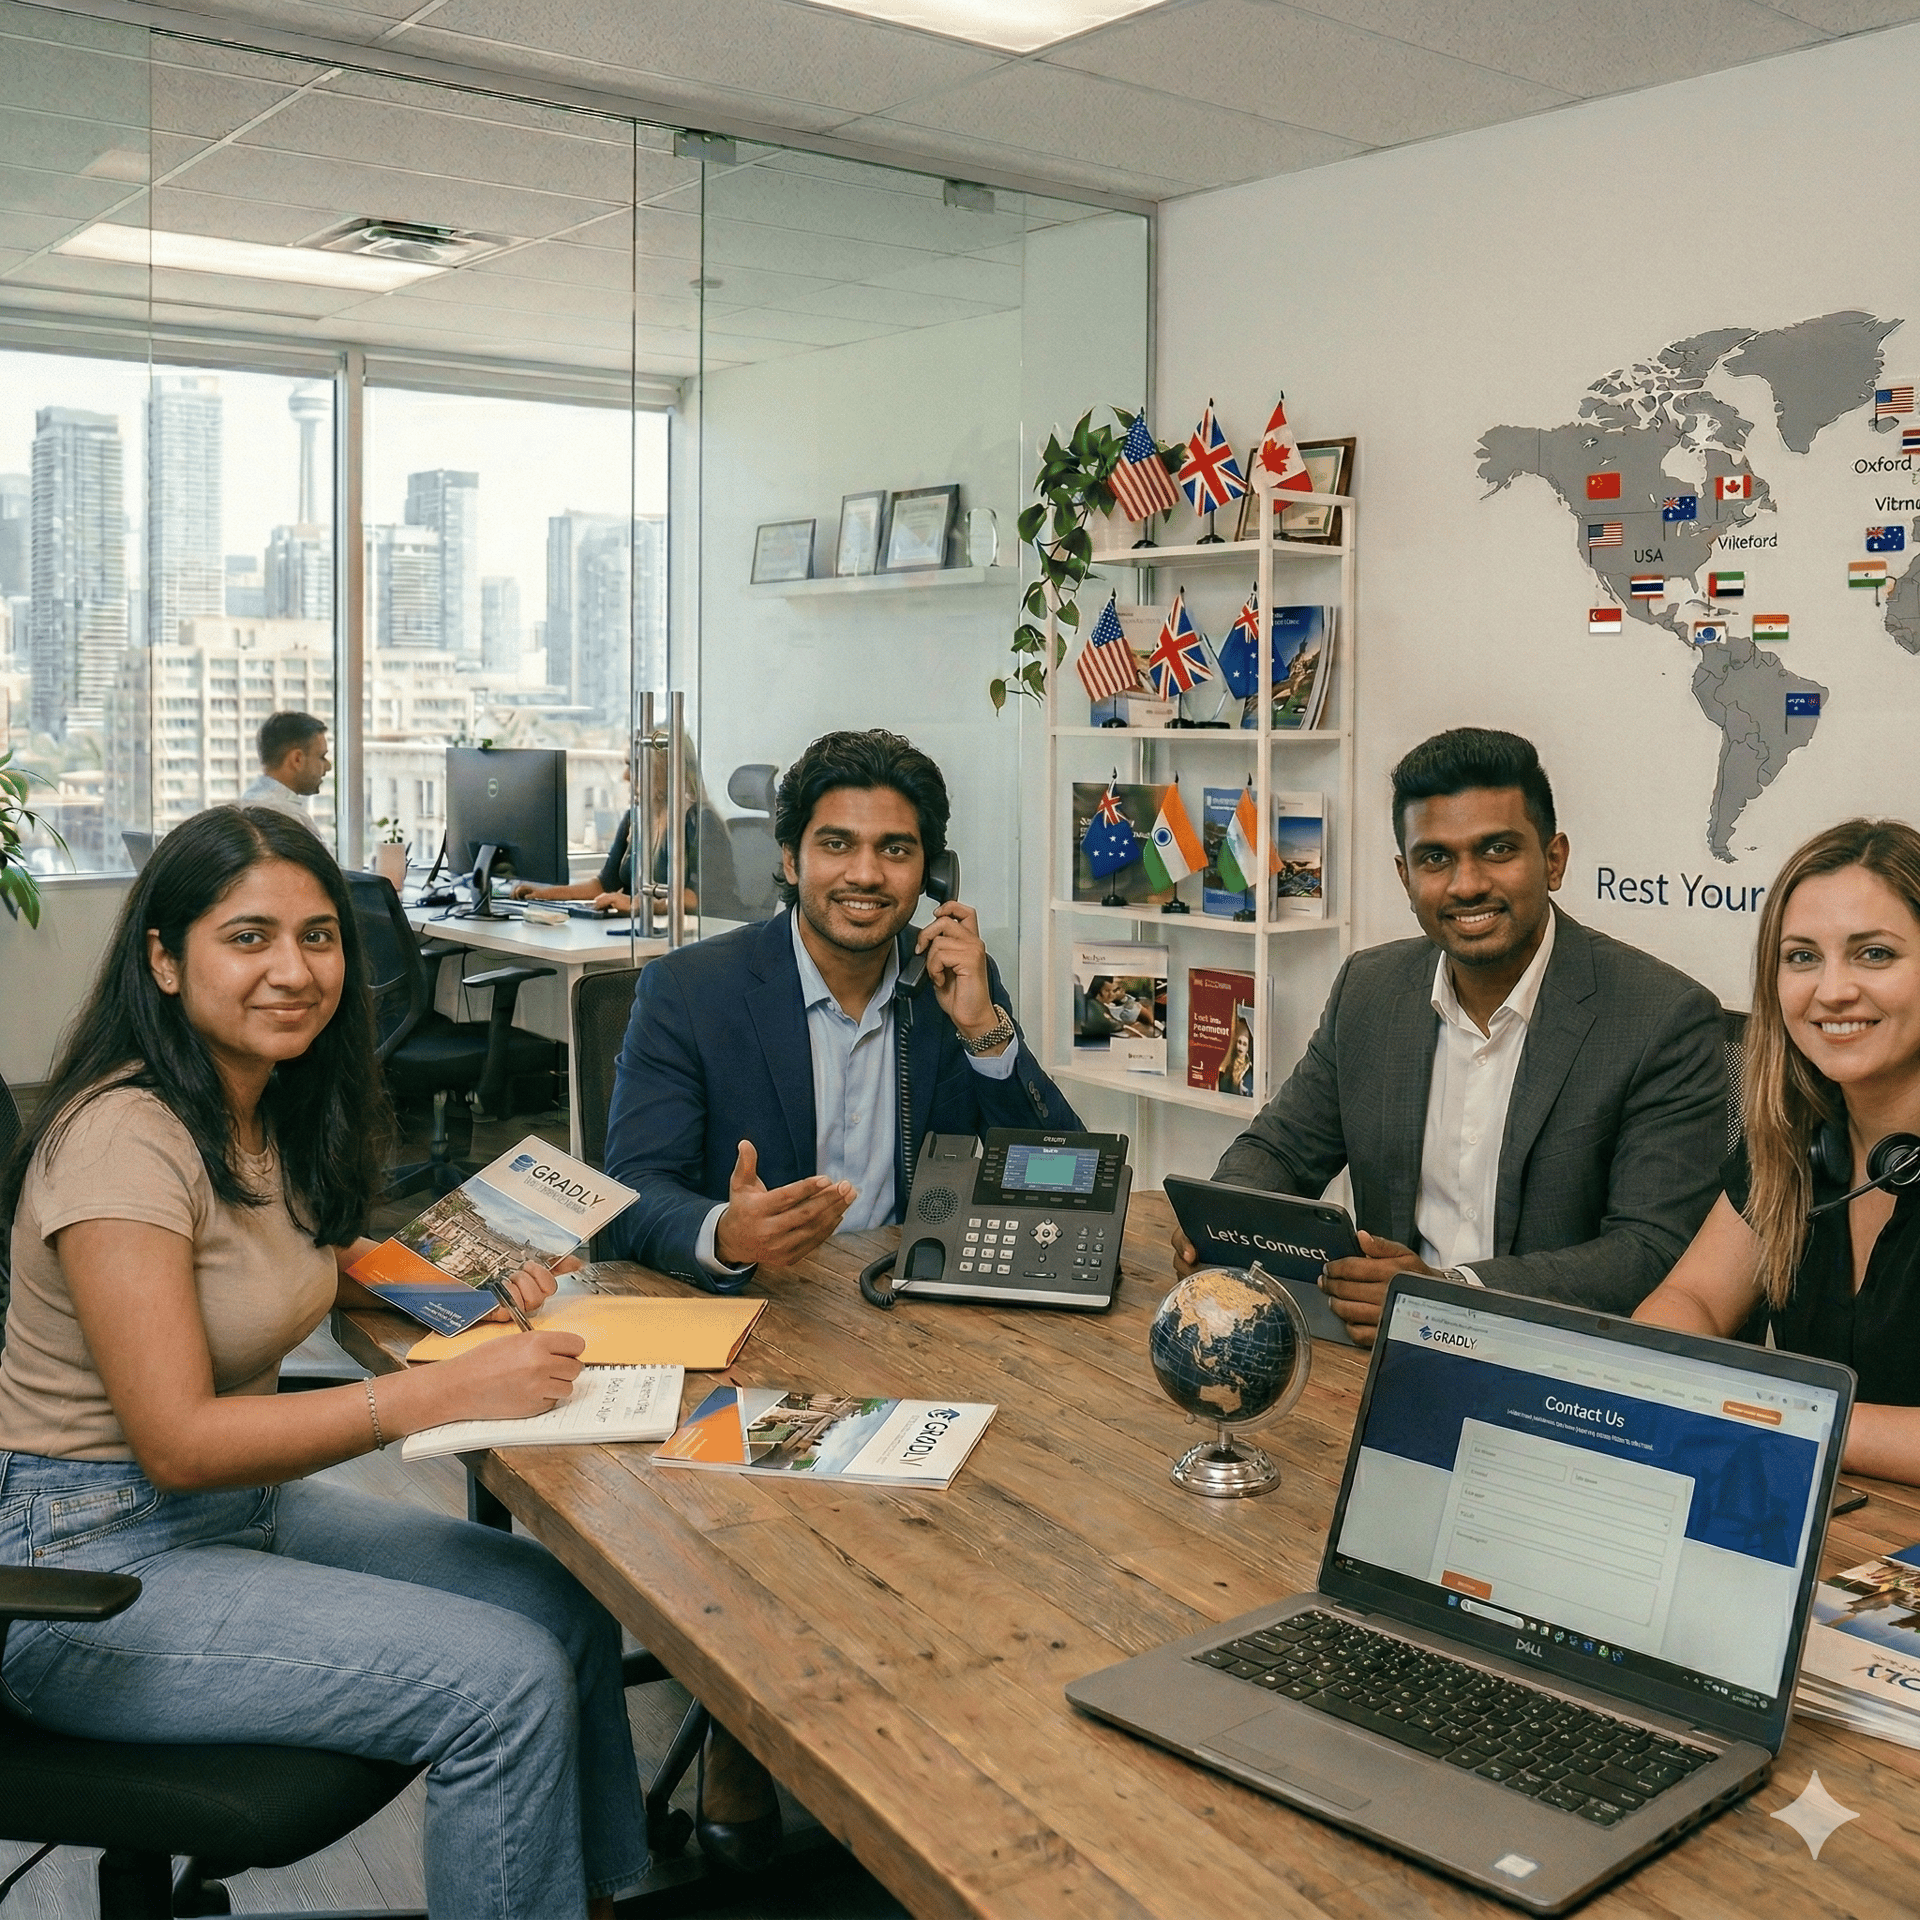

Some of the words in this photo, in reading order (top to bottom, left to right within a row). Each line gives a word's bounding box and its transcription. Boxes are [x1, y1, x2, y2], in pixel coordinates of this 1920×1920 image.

[1854, 454, 1912, 474] Oxford
[1634, 548, 1664, 563] USA
[1597, 867, 1669, 906] Rest
[1680, 872, 1766, 913] Your
[531, 1164, 606, 1209] GRADLY
[1206, 1223, 1250, 1246] Let's
[1252, 1234, 1330, 1262] Connect
[1433, 1330, 1478, 1350] GRADLY
[1545, 1395, 1603, 1423] Contact
[1605, 1409, 1625, 1428] Us
